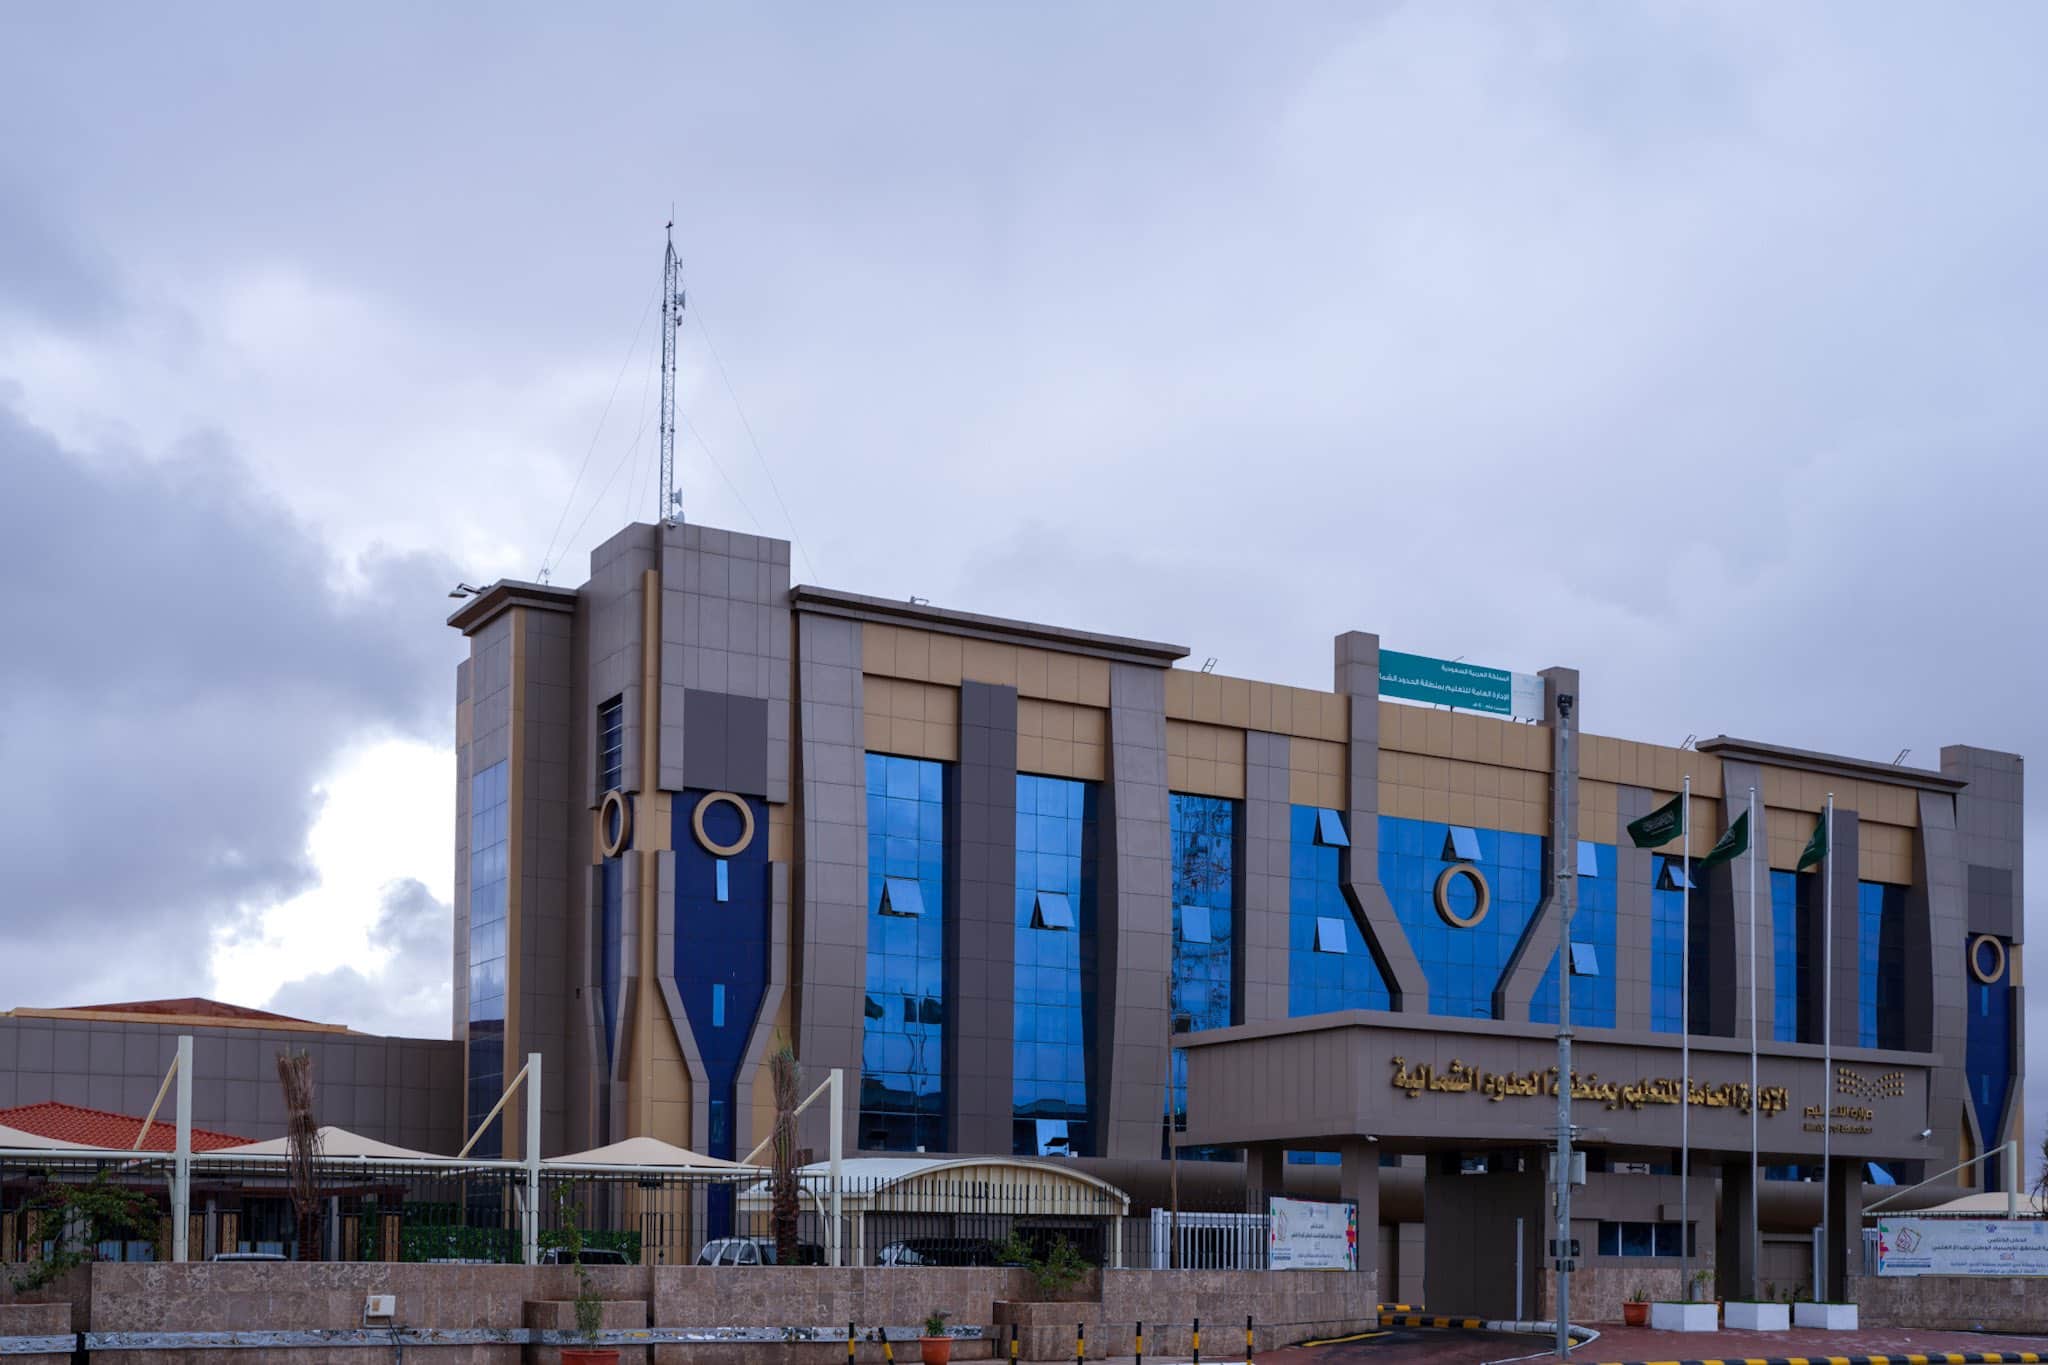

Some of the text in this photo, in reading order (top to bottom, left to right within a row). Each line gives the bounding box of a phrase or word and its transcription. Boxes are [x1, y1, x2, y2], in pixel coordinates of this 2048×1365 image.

[1441, 663, 1468, 676] السعودية
[1391, 1056, 1481, 1098] الشمالية
[1483, 1070, 1549, 1102] الحدود
[1551, 1063, 1618, 1110] بمنطة
[1685, 1078, 1737, 1107] العامة
[1619, 1077, 1682, 1110] للتعليم
[1849, 1105, 1873, 1121] وزارة
